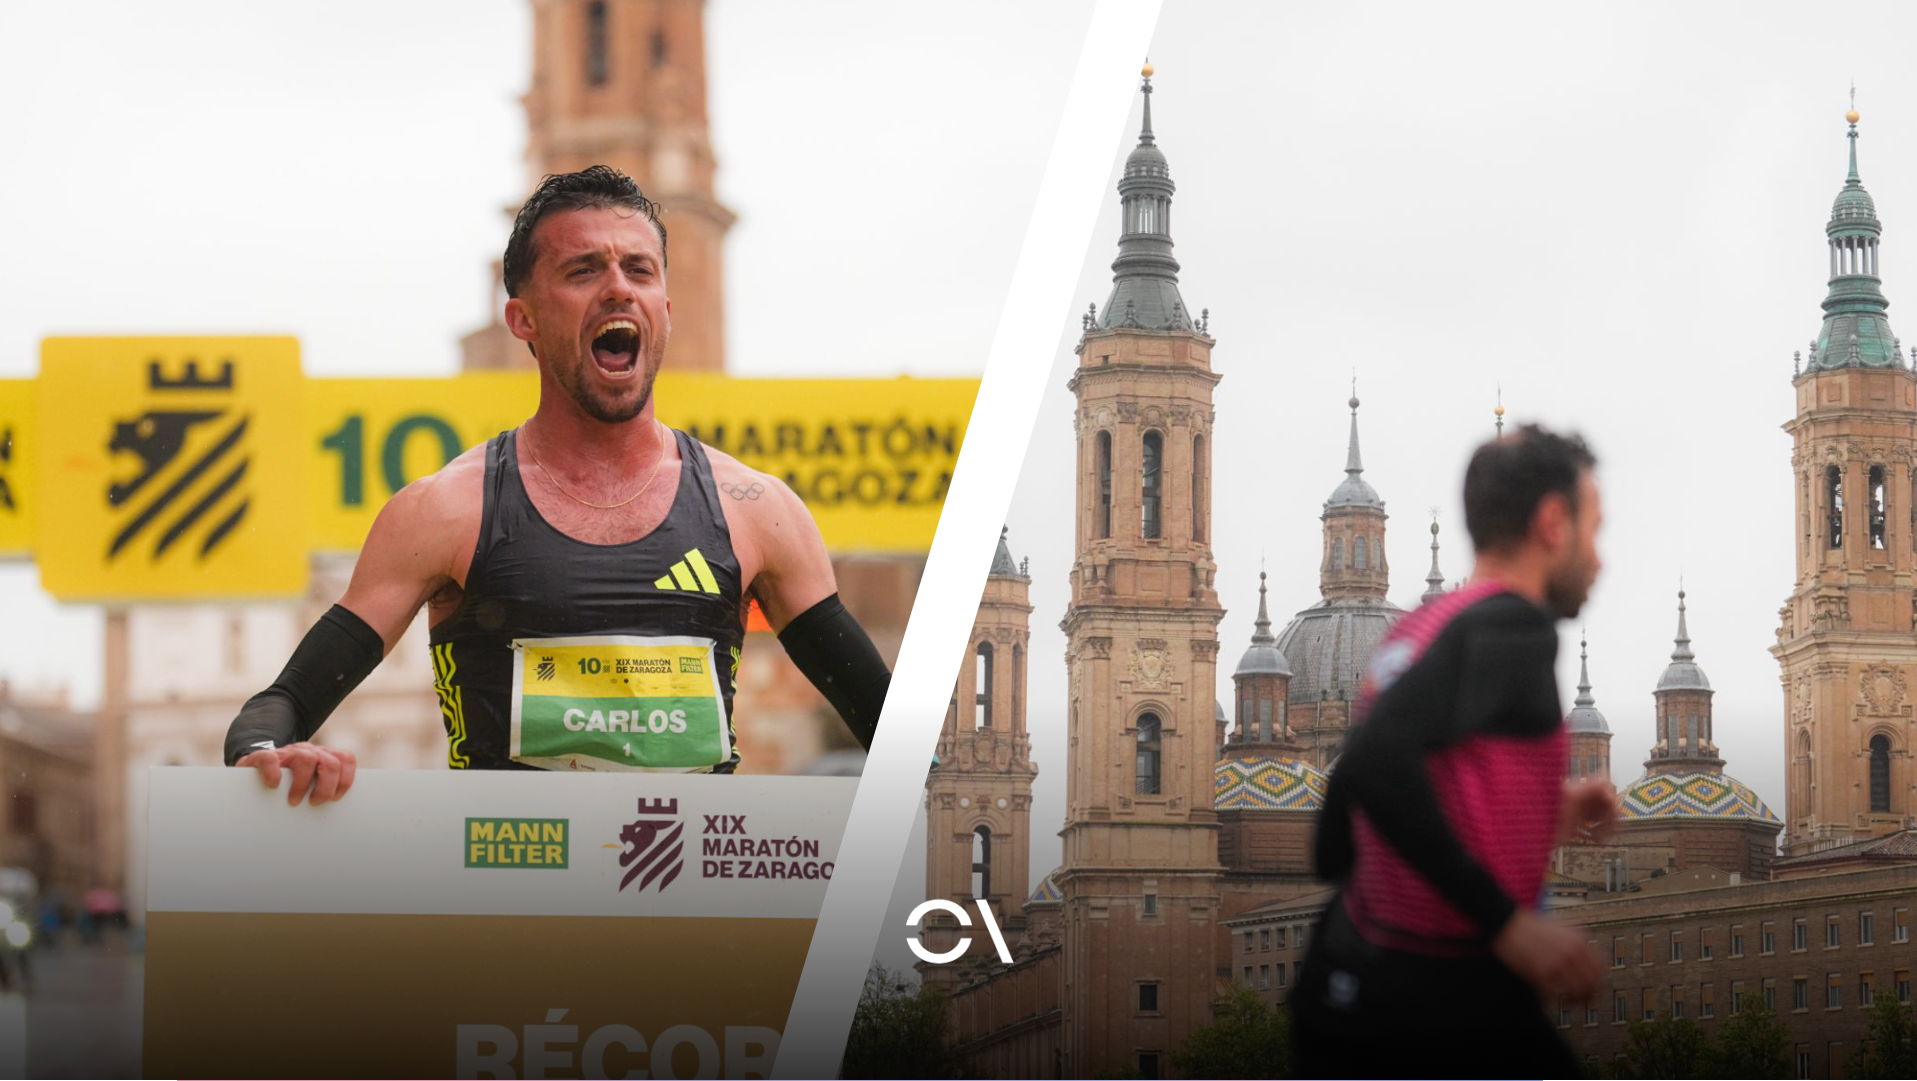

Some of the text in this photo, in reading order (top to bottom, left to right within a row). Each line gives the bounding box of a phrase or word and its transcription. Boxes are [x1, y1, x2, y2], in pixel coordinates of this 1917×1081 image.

[322, 414, 464, 506] 10
[578, 657, 602, 675] 10
[632, 658, 671, 666] MARATÓN
[616, 666, 628, 674] DE
[629, 666, 673, 674] ZARAGOZA
[563, 708, 687, 733] CARLOS
[623, 742, 631, 757] 1
[470, 822, 563, 842] MANN
[702, 814, 747, 834] XIX
[470, 844, 563, 864] FILTER
[702, 836, 819, 857] MARATÓN
[702, 860, 835, 880] DE ZARAGO
